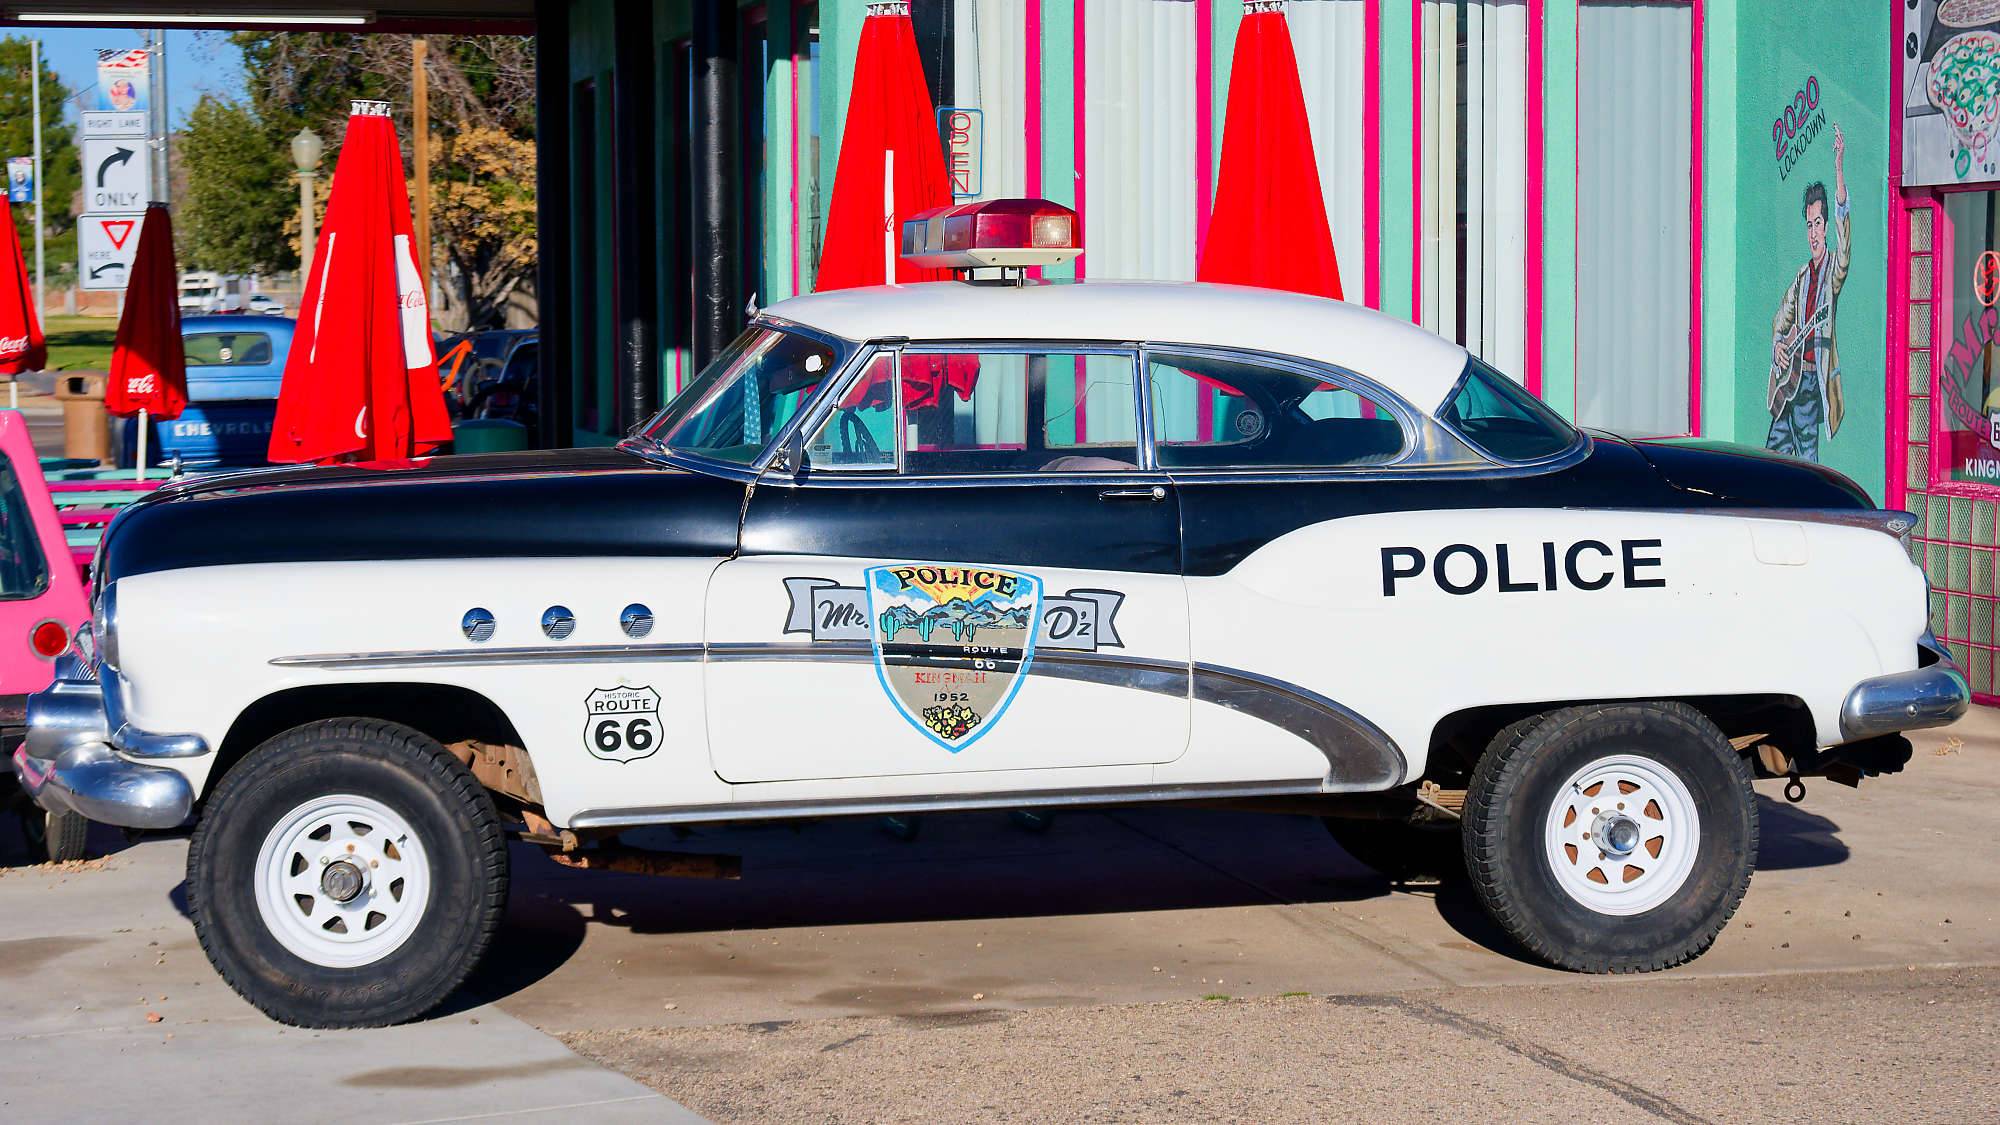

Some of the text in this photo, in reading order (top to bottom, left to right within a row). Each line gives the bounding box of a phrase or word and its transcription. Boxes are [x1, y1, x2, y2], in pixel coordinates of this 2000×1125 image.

[88, 119, 142, 128] RIGHT LANE
[1773, 76, 1819, 161] 2020
[949, 112, 971, 192] OPEN
[1779, 108, 1826, 181] LOCKDOWN
[95, 192, 138, 207] ONLY
[174, 422, 273, 437] CHEVROLE
[1381, 539, 1666, 596] POLICE
[892, 568, 1017, 598] POLICE
[818, 599, 869, 629] Mr.
[963, 646, 1008, 654] ROUTE
[975, 660, 996, 670] 66
[595, 699, 651, 712] ROUTE
[934, 693, 969, 702] 1952
[595, 719, 652, 752] 66
